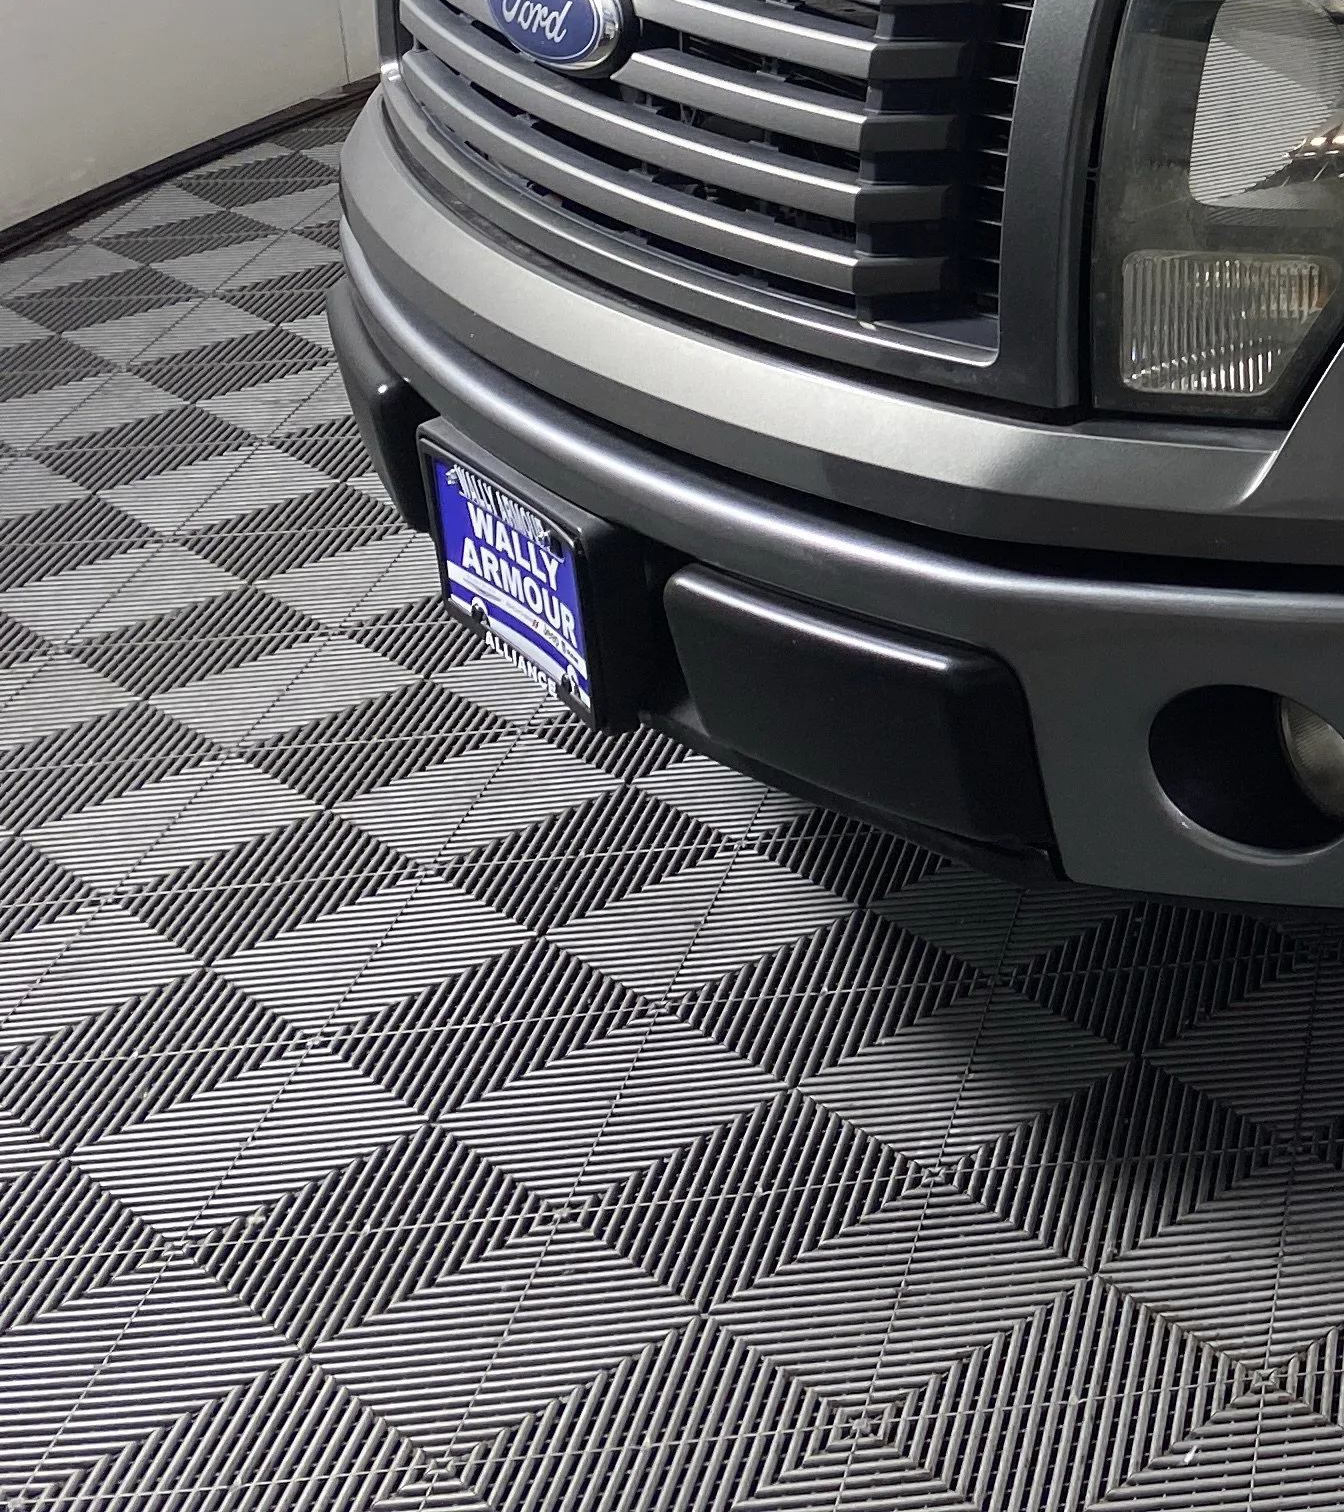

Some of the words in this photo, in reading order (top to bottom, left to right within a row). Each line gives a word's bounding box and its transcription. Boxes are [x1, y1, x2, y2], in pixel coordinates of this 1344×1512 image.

[453, 463, 498, 517] WALLY
[466, 501, 559, 591] WALLY
[461, 536, 578, 649] ARMOUR
[485, 630, 558, 699] ALLIANCE
